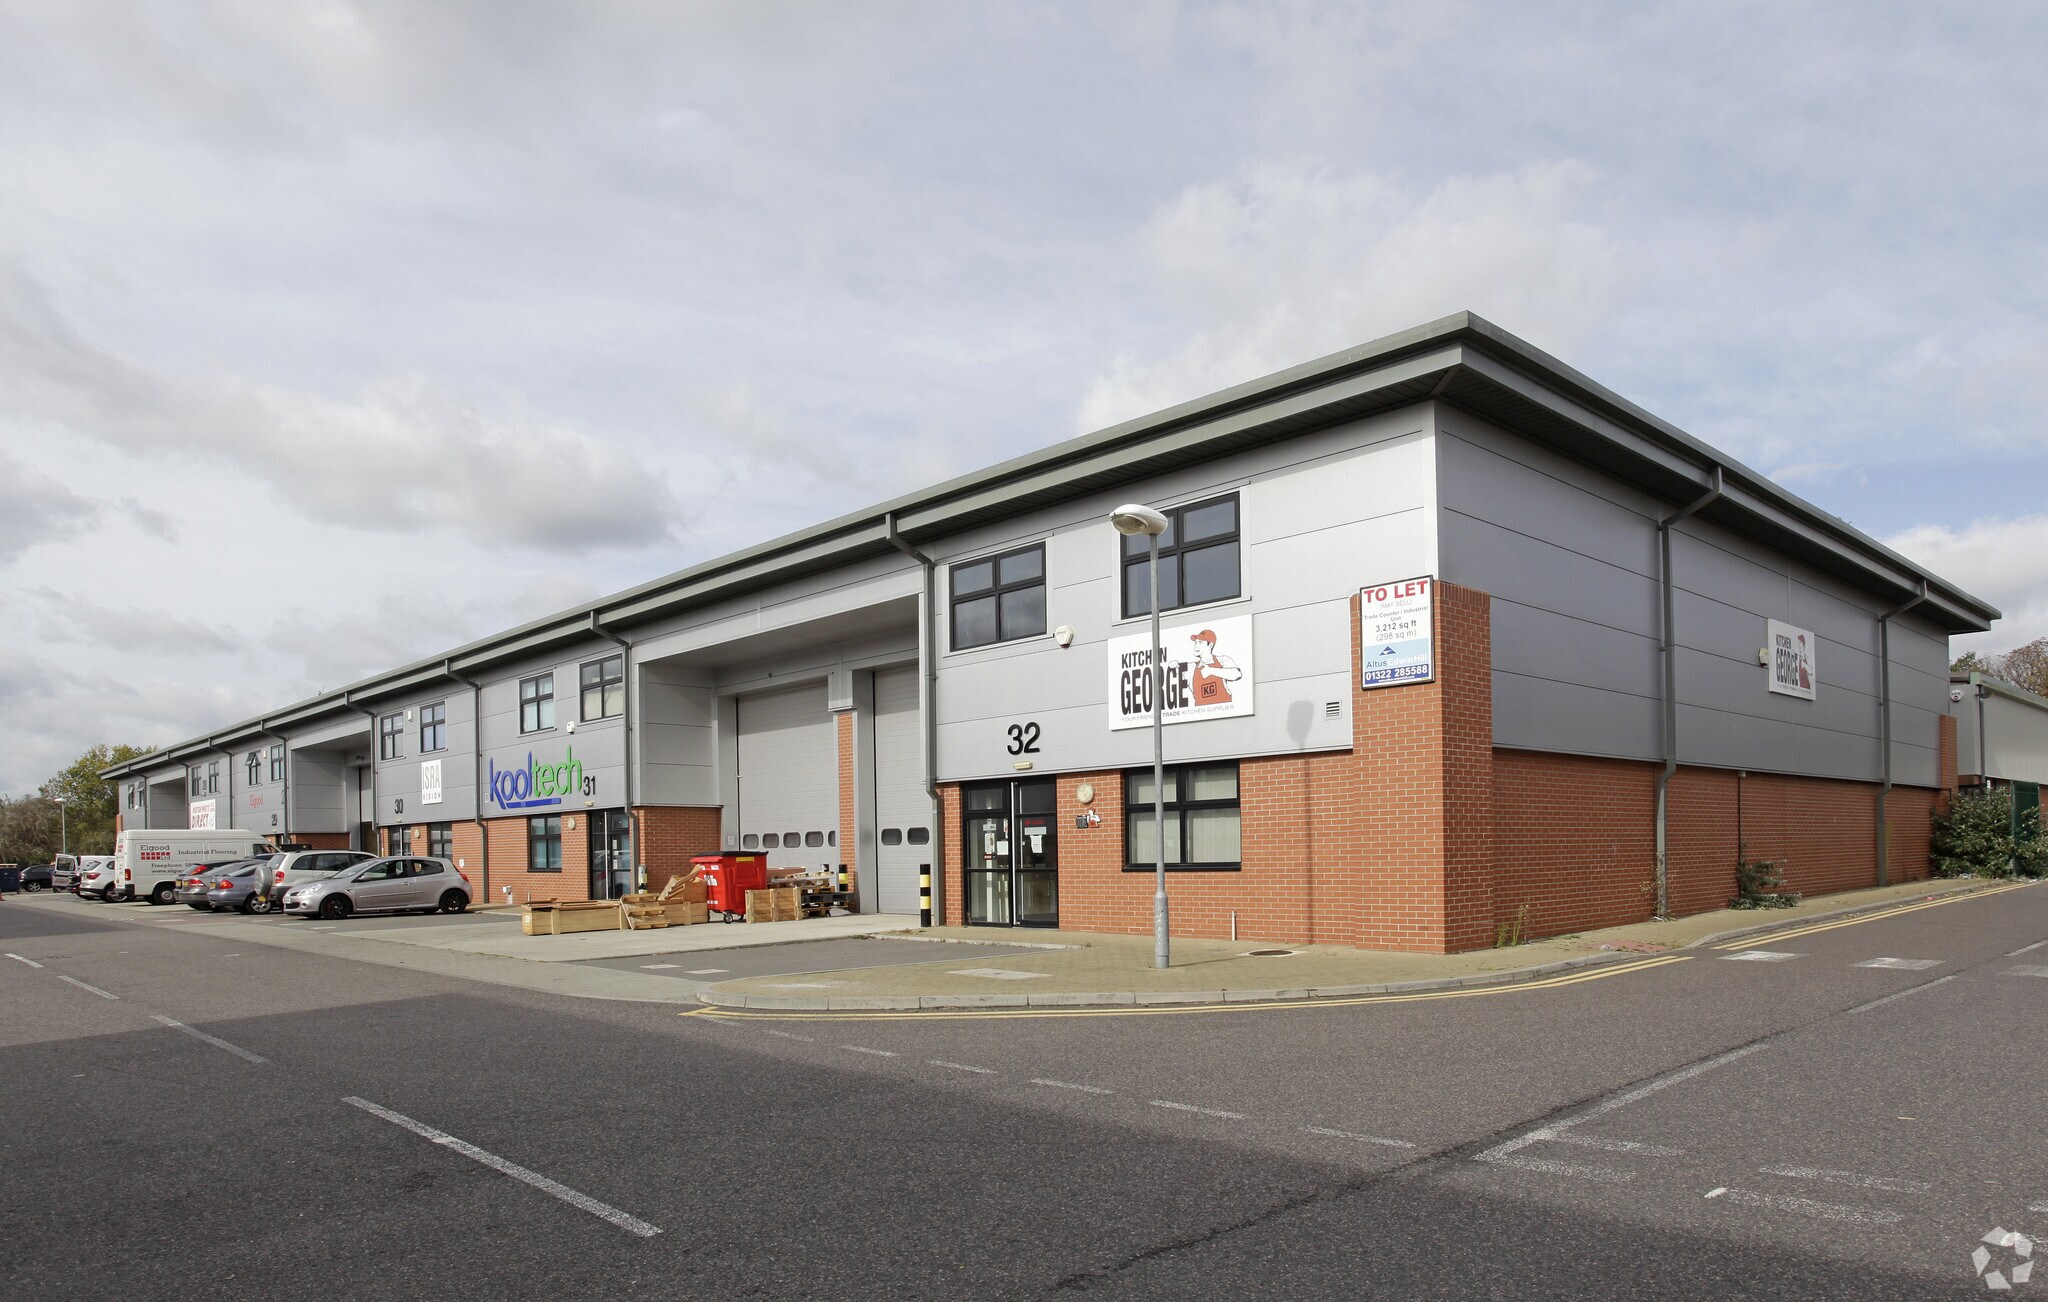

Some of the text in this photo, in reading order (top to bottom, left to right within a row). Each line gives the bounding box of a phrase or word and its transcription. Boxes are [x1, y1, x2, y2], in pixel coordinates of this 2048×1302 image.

[1364, 580, 1428, 603] TO LET
[1404, 605, 1429, 613] Industrial
[1399, 622, 1409, 630] sq
[1376, 631, 1393, 642] (298
[1407, 629, 1417, 638] m)
[1776, 633, 1792, 650] KITCHEN
[1121, 647, 1167, 669] KITCHN
[1366, 660, 1387, 668] Altus
[1366, 670, 1391, 680] 01322
[1394, 665, 1428, 677] 285588
[1776, 647, 1799, 687] GEORGE
[1203, 685, 1215, 696] KG
[1207, 704, 1234, 712] SUPPLIER
[1007, 721, 1041, 755] 32
[422, 765, 441, 790] ISRA
[489, 745, 583, 809] kooltech
[583, 775, 596, 796] 31
[394, 798, 404, 814] 30
[192, 813, 209, 828] DIRECT
